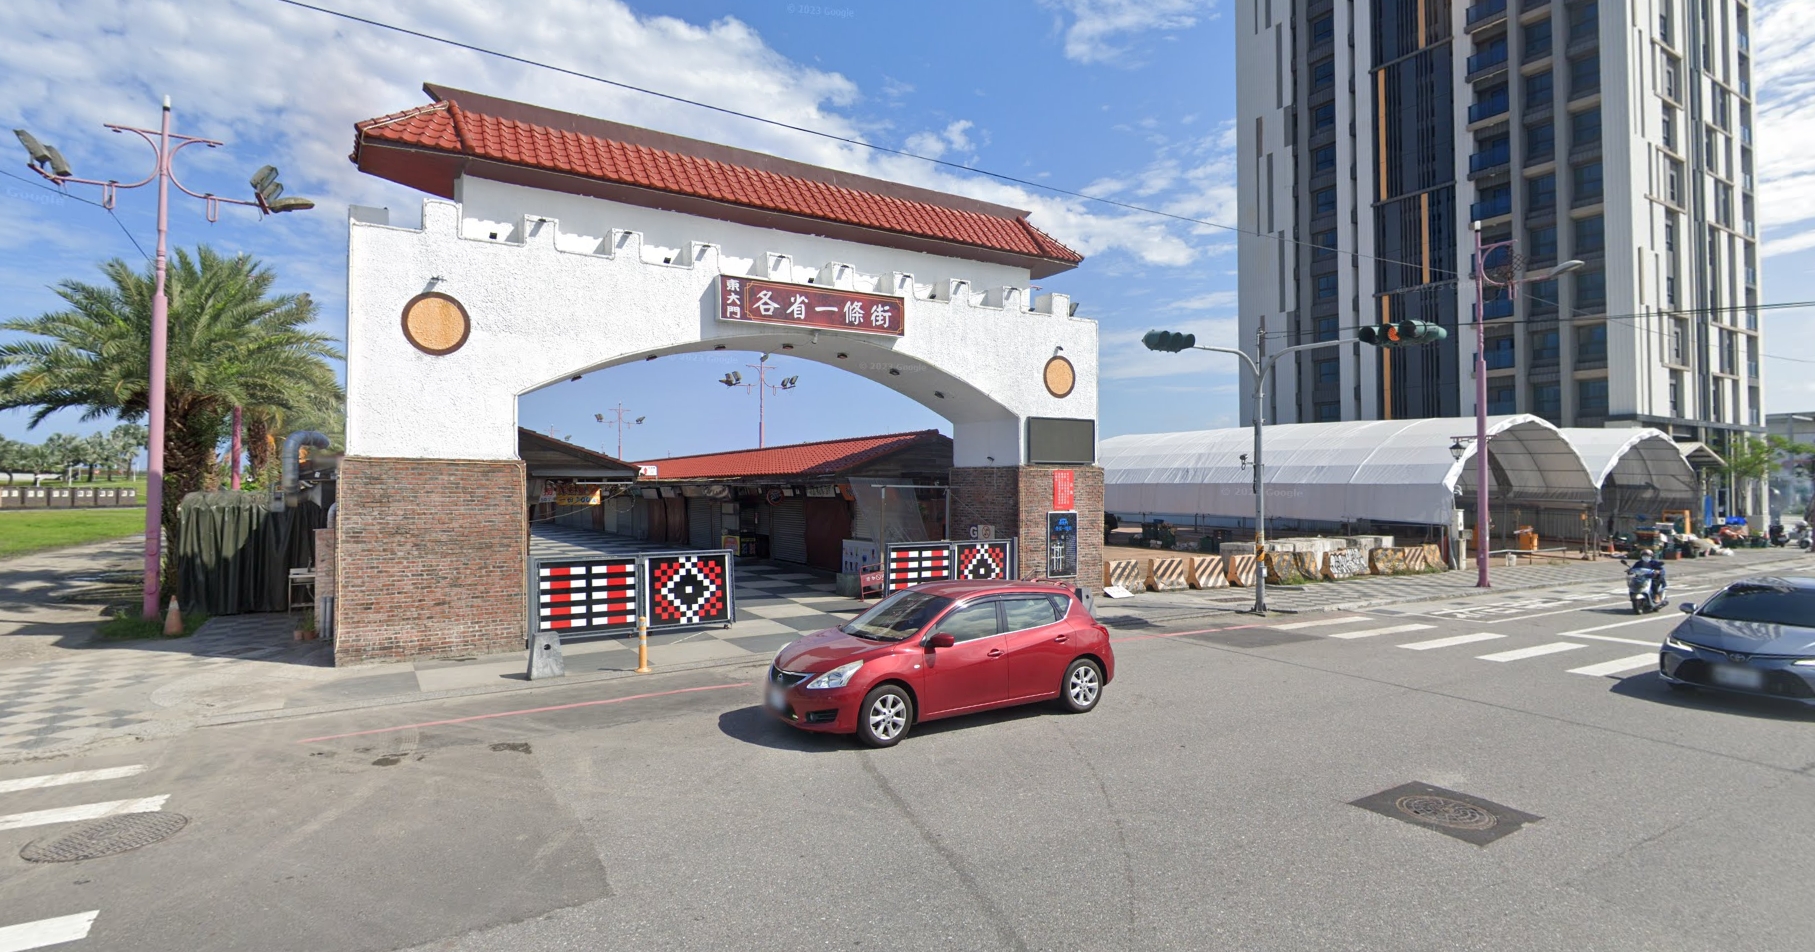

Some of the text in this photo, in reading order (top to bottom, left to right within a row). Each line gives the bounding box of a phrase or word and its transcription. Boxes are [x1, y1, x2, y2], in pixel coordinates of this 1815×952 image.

[726, 278, 741, 319] 東大門
[752, 290, 892, 328] 各省一條街
[969, 526, 978, 538] G
